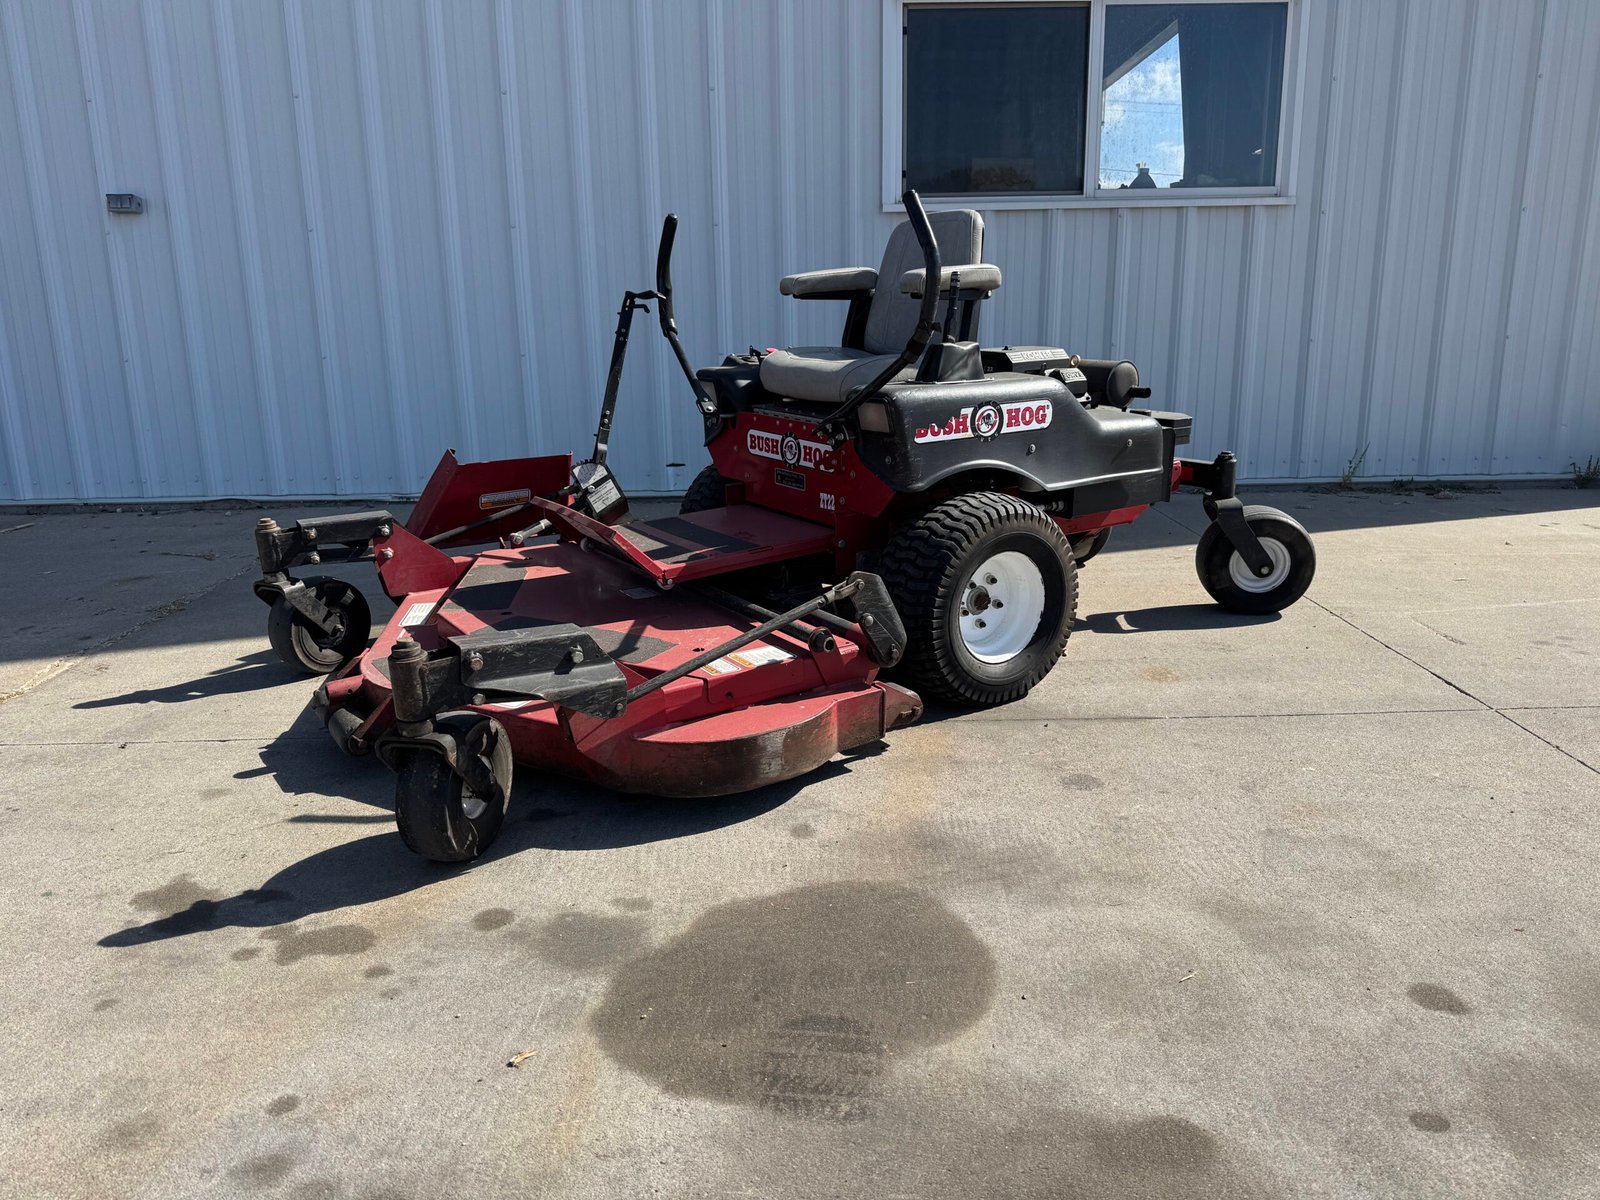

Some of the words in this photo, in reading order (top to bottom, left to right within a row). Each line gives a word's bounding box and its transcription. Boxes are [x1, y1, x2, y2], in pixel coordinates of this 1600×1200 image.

[1020, 349, 1053, 361] KOHLER
[1006, 404, 1047, 428] HOG
[749, 433, 780, 456] BUSH
[819, 492, 836, 511] ZT22
